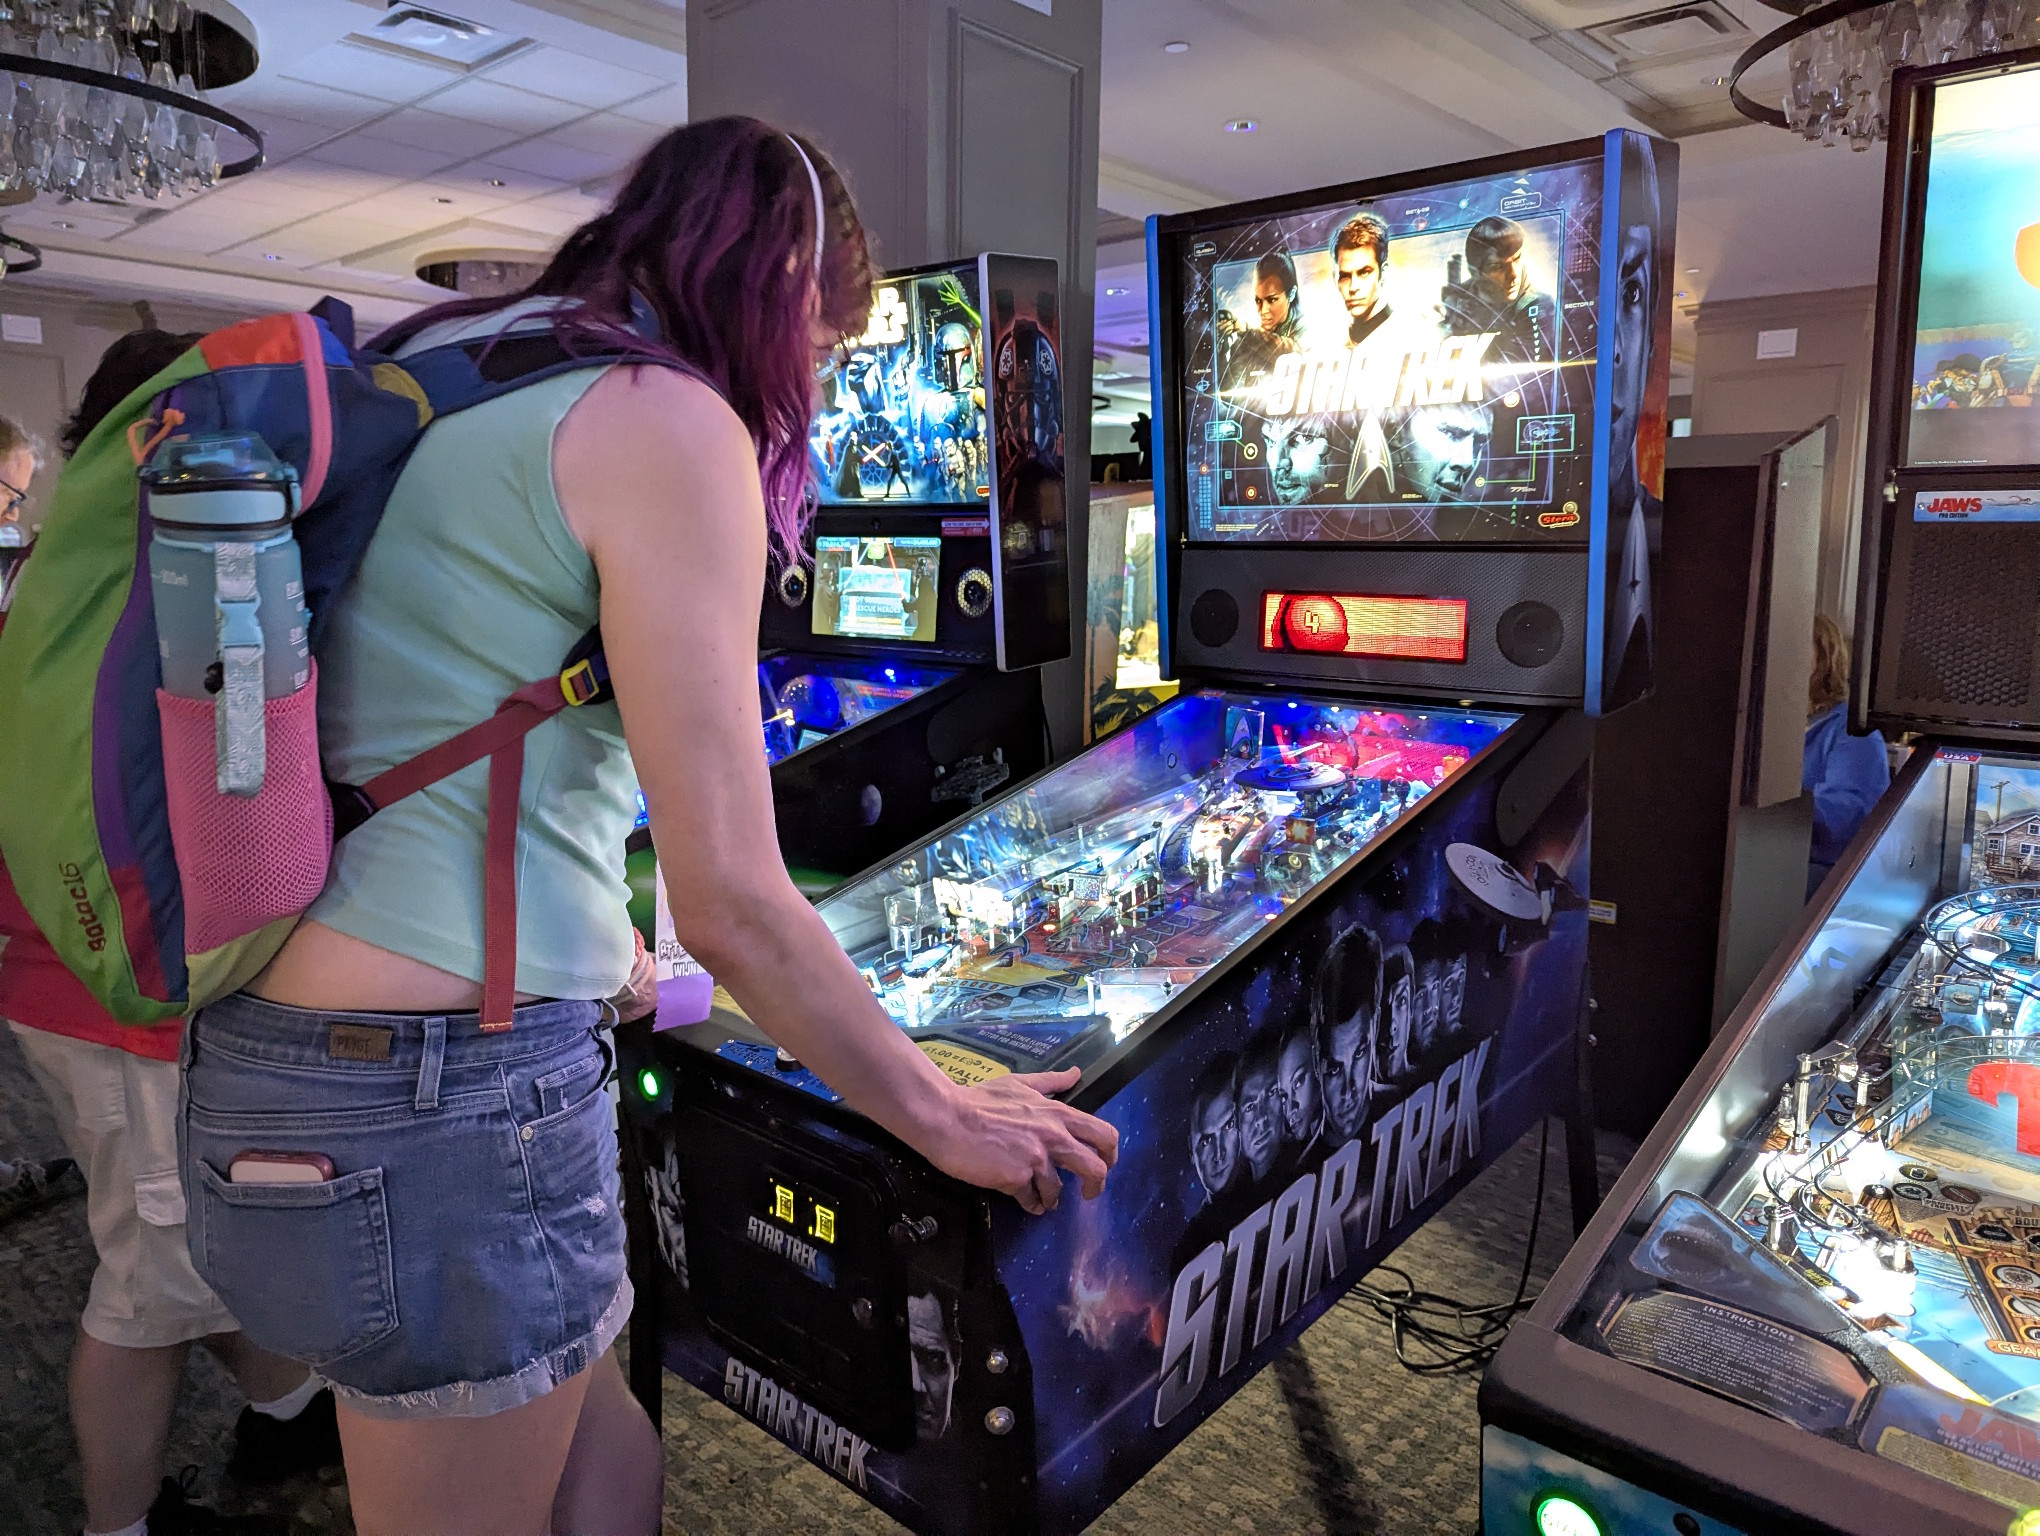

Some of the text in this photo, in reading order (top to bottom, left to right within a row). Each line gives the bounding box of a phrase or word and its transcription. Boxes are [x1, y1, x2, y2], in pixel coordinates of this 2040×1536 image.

[1266, 331, 1502, 415] STAR TREK
[1543, 515, 1576, 525] Stern
[1927, 497, 1982, 513] JAWS
[1304, 610, 1321, 635] 4
[747, 1215, 785, 1255] STAR
[785, 1233, 818, 1273] TREK
[1154, 1138, 1362, 1428] STAR
[1364, 1036, 1493, 1249] TREK
[1703, 1305, 1796, 1342] INSTRUCTIONS
[724, 1356, 872, 1492] STAR TREK
